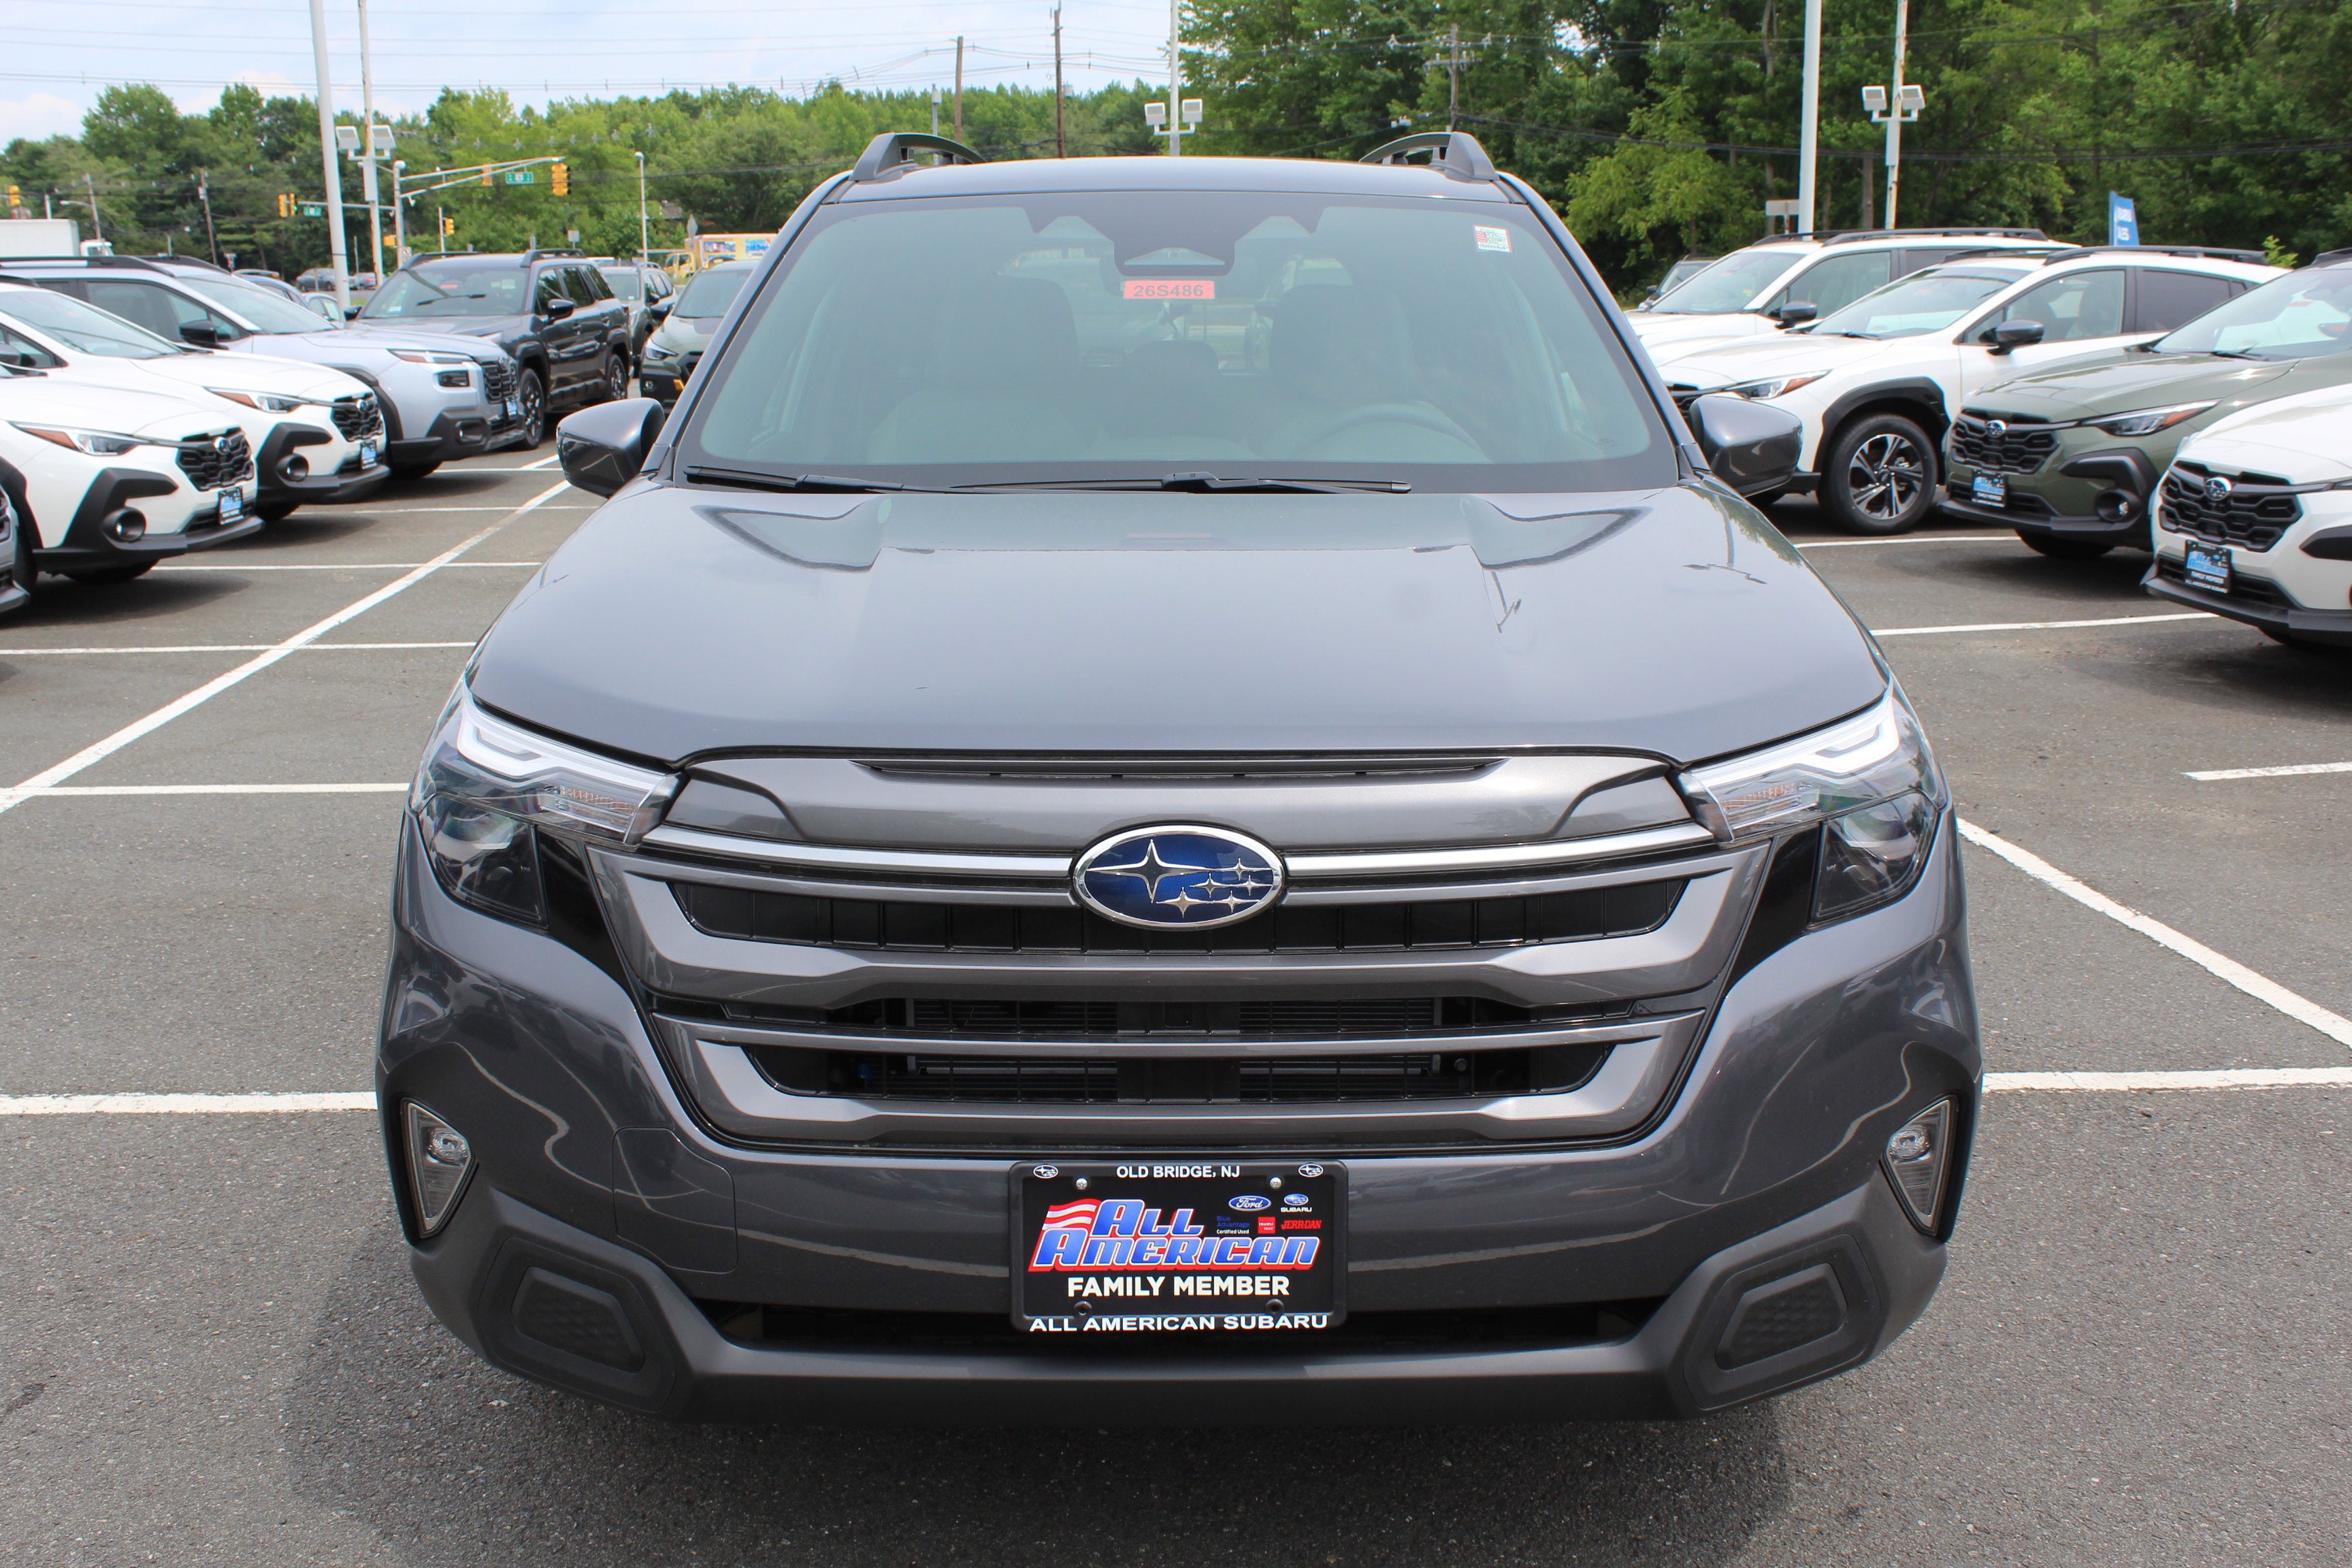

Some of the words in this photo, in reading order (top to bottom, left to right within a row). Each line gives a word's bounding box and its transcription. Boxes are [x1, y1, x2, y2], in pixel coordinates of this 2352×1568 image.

[1133, 284, 1204, 297] 26S486
[1116, 1166, 1149, 1178] OLD
[1153, 1165, 1217, 1179] BRIDGE,
[1221, 1165, 1241, 1177] NJ
[1236, 1197, 1263, 1208] Ford
[1090, 1199, 1205, 1237] ALL
[1032, 1227, 1320, 1267] AMERICAN
[1068, 1276, 1165, 1297] FAMILY
[1173, 1276, 1290, 1296] MEMBER
[1029, 1318, 1077, 1332] ALL
[1083, 1316, 1215, 1331] AMERICAN
[1223, 1315, 1328, 1329] SUBARU
